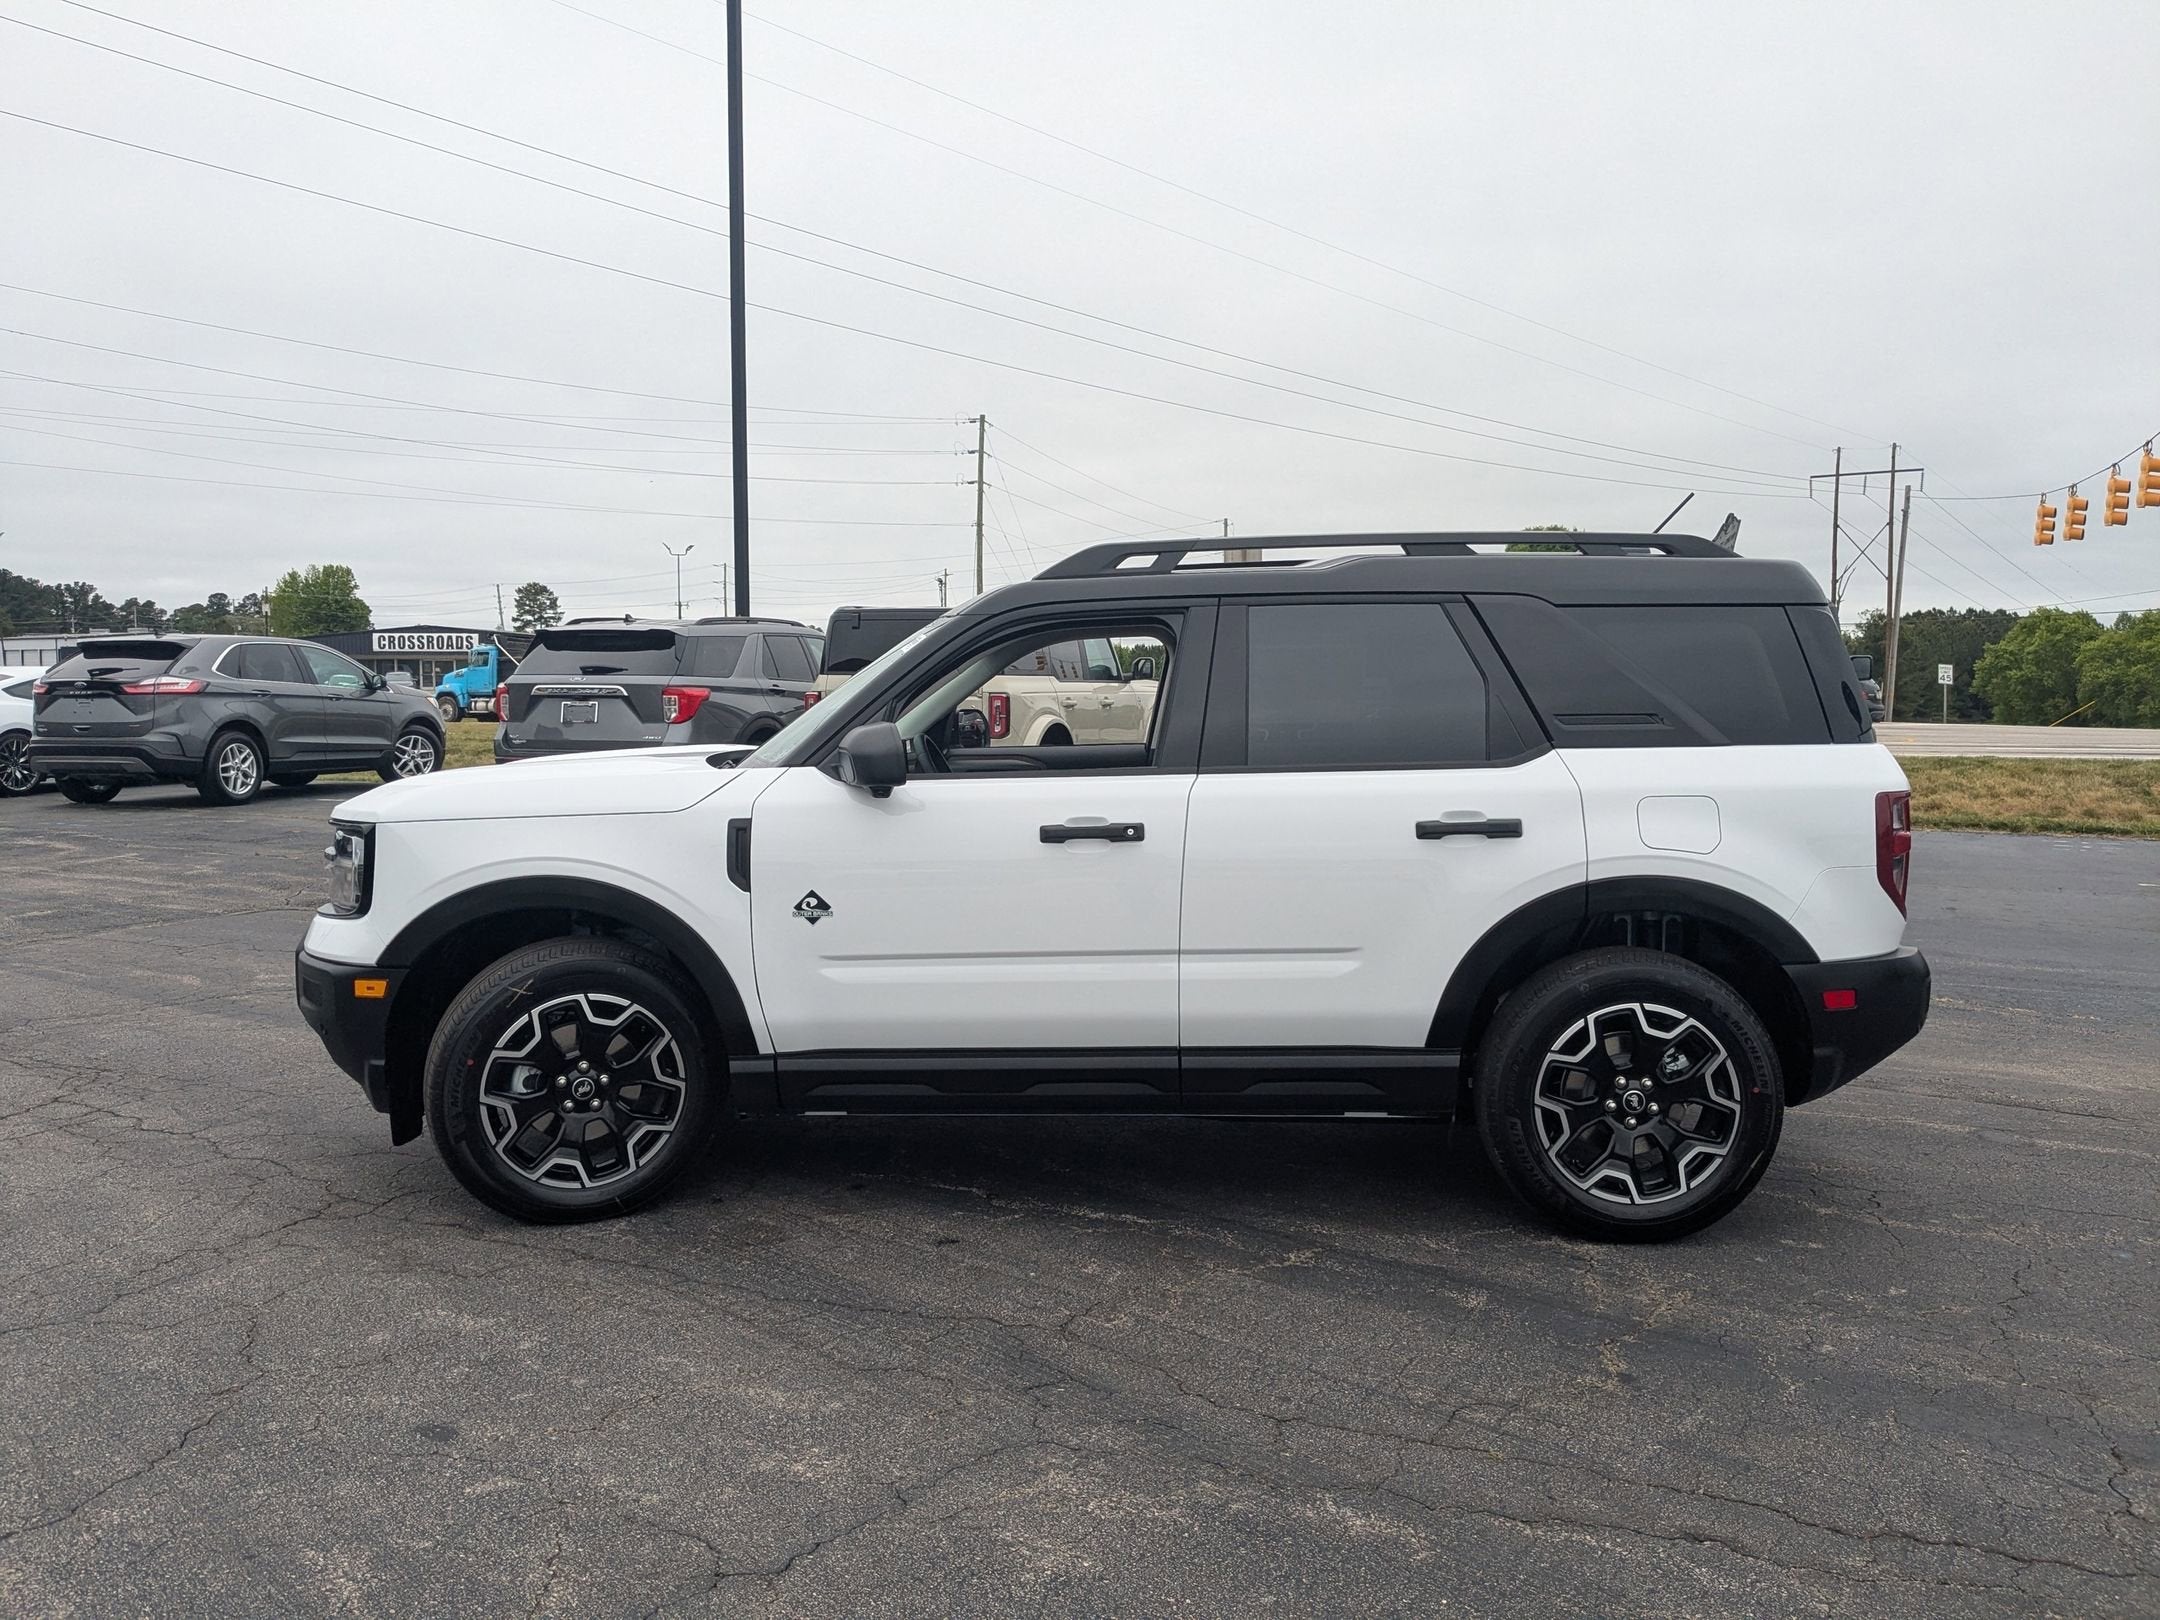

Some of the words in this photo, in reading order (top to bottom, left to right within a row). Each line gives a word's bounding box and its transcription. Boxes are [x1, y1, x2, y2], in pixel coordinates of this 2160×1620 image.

[377, 634, 474, 650] CROSSROADS
[1939, 674, 1952, 682] 45
[1731, 1020, 1769, 1089] MICHELIN
